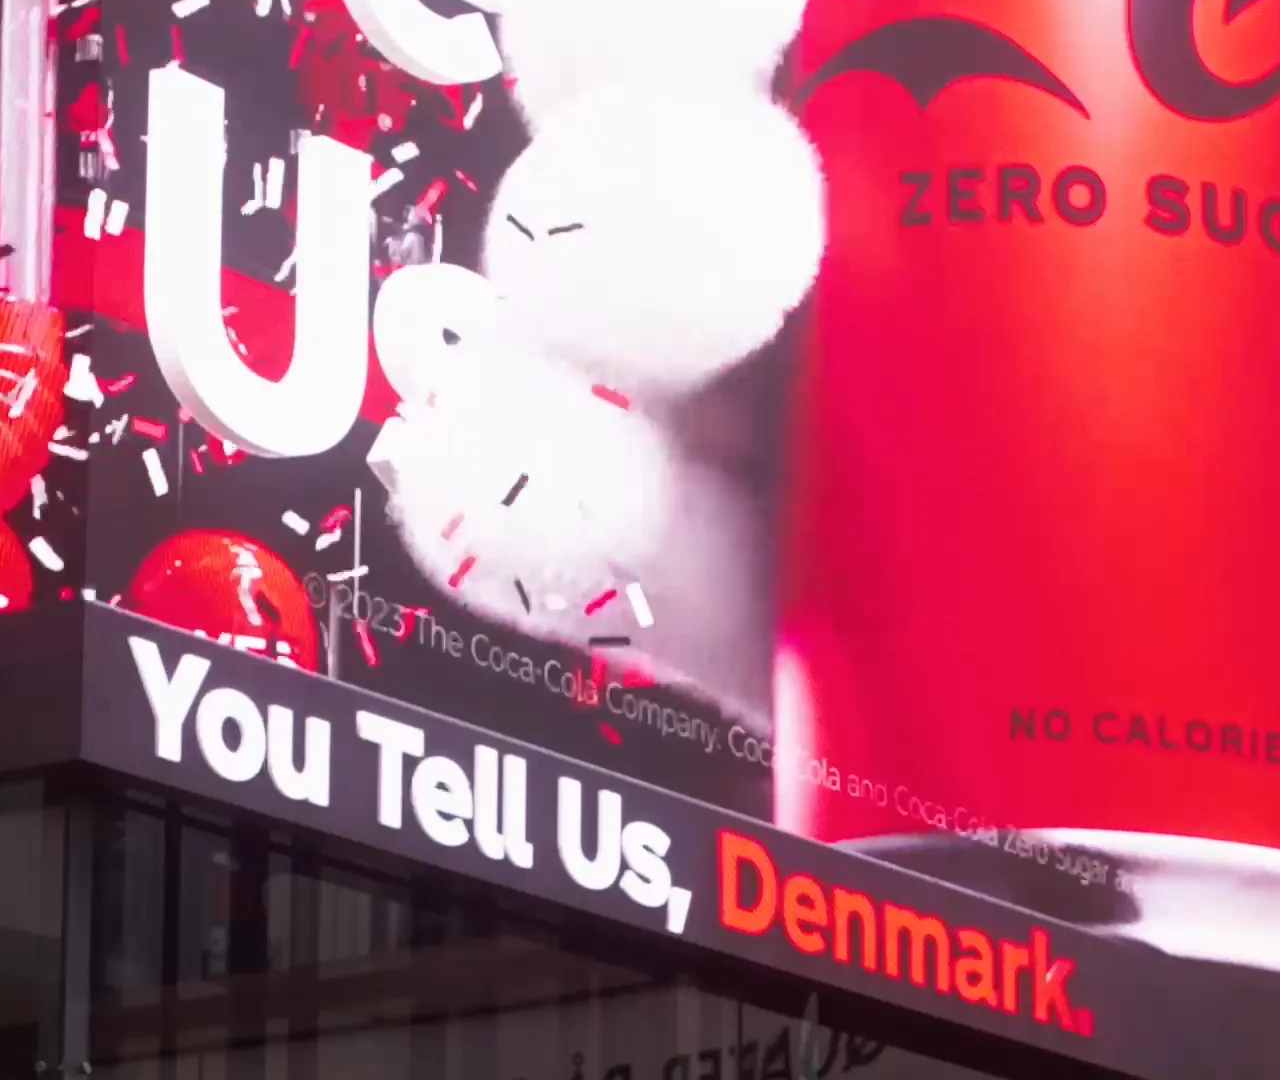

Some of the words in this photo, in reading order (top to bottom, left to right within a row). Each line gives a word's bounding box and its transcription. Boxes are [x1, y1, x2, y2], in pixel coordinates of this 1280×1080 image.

[898, 163, 1107, 228] ZERO
[336, 582, 405, 638] 2023
[414, 609, 463, 658] The
[470, 633, 600, 706] Coca-Cola
[846, 774, 888, 807] and
[893, 785, 999, 849] Coca-Cola
[1009, 706, 1071, 741] NO
[128, 635, 332, 807] You
[356, 710, 535, 870] Tell
[556, 776, 694, 935] Us,
[715, 827, 1097, 1038] Denmark.
